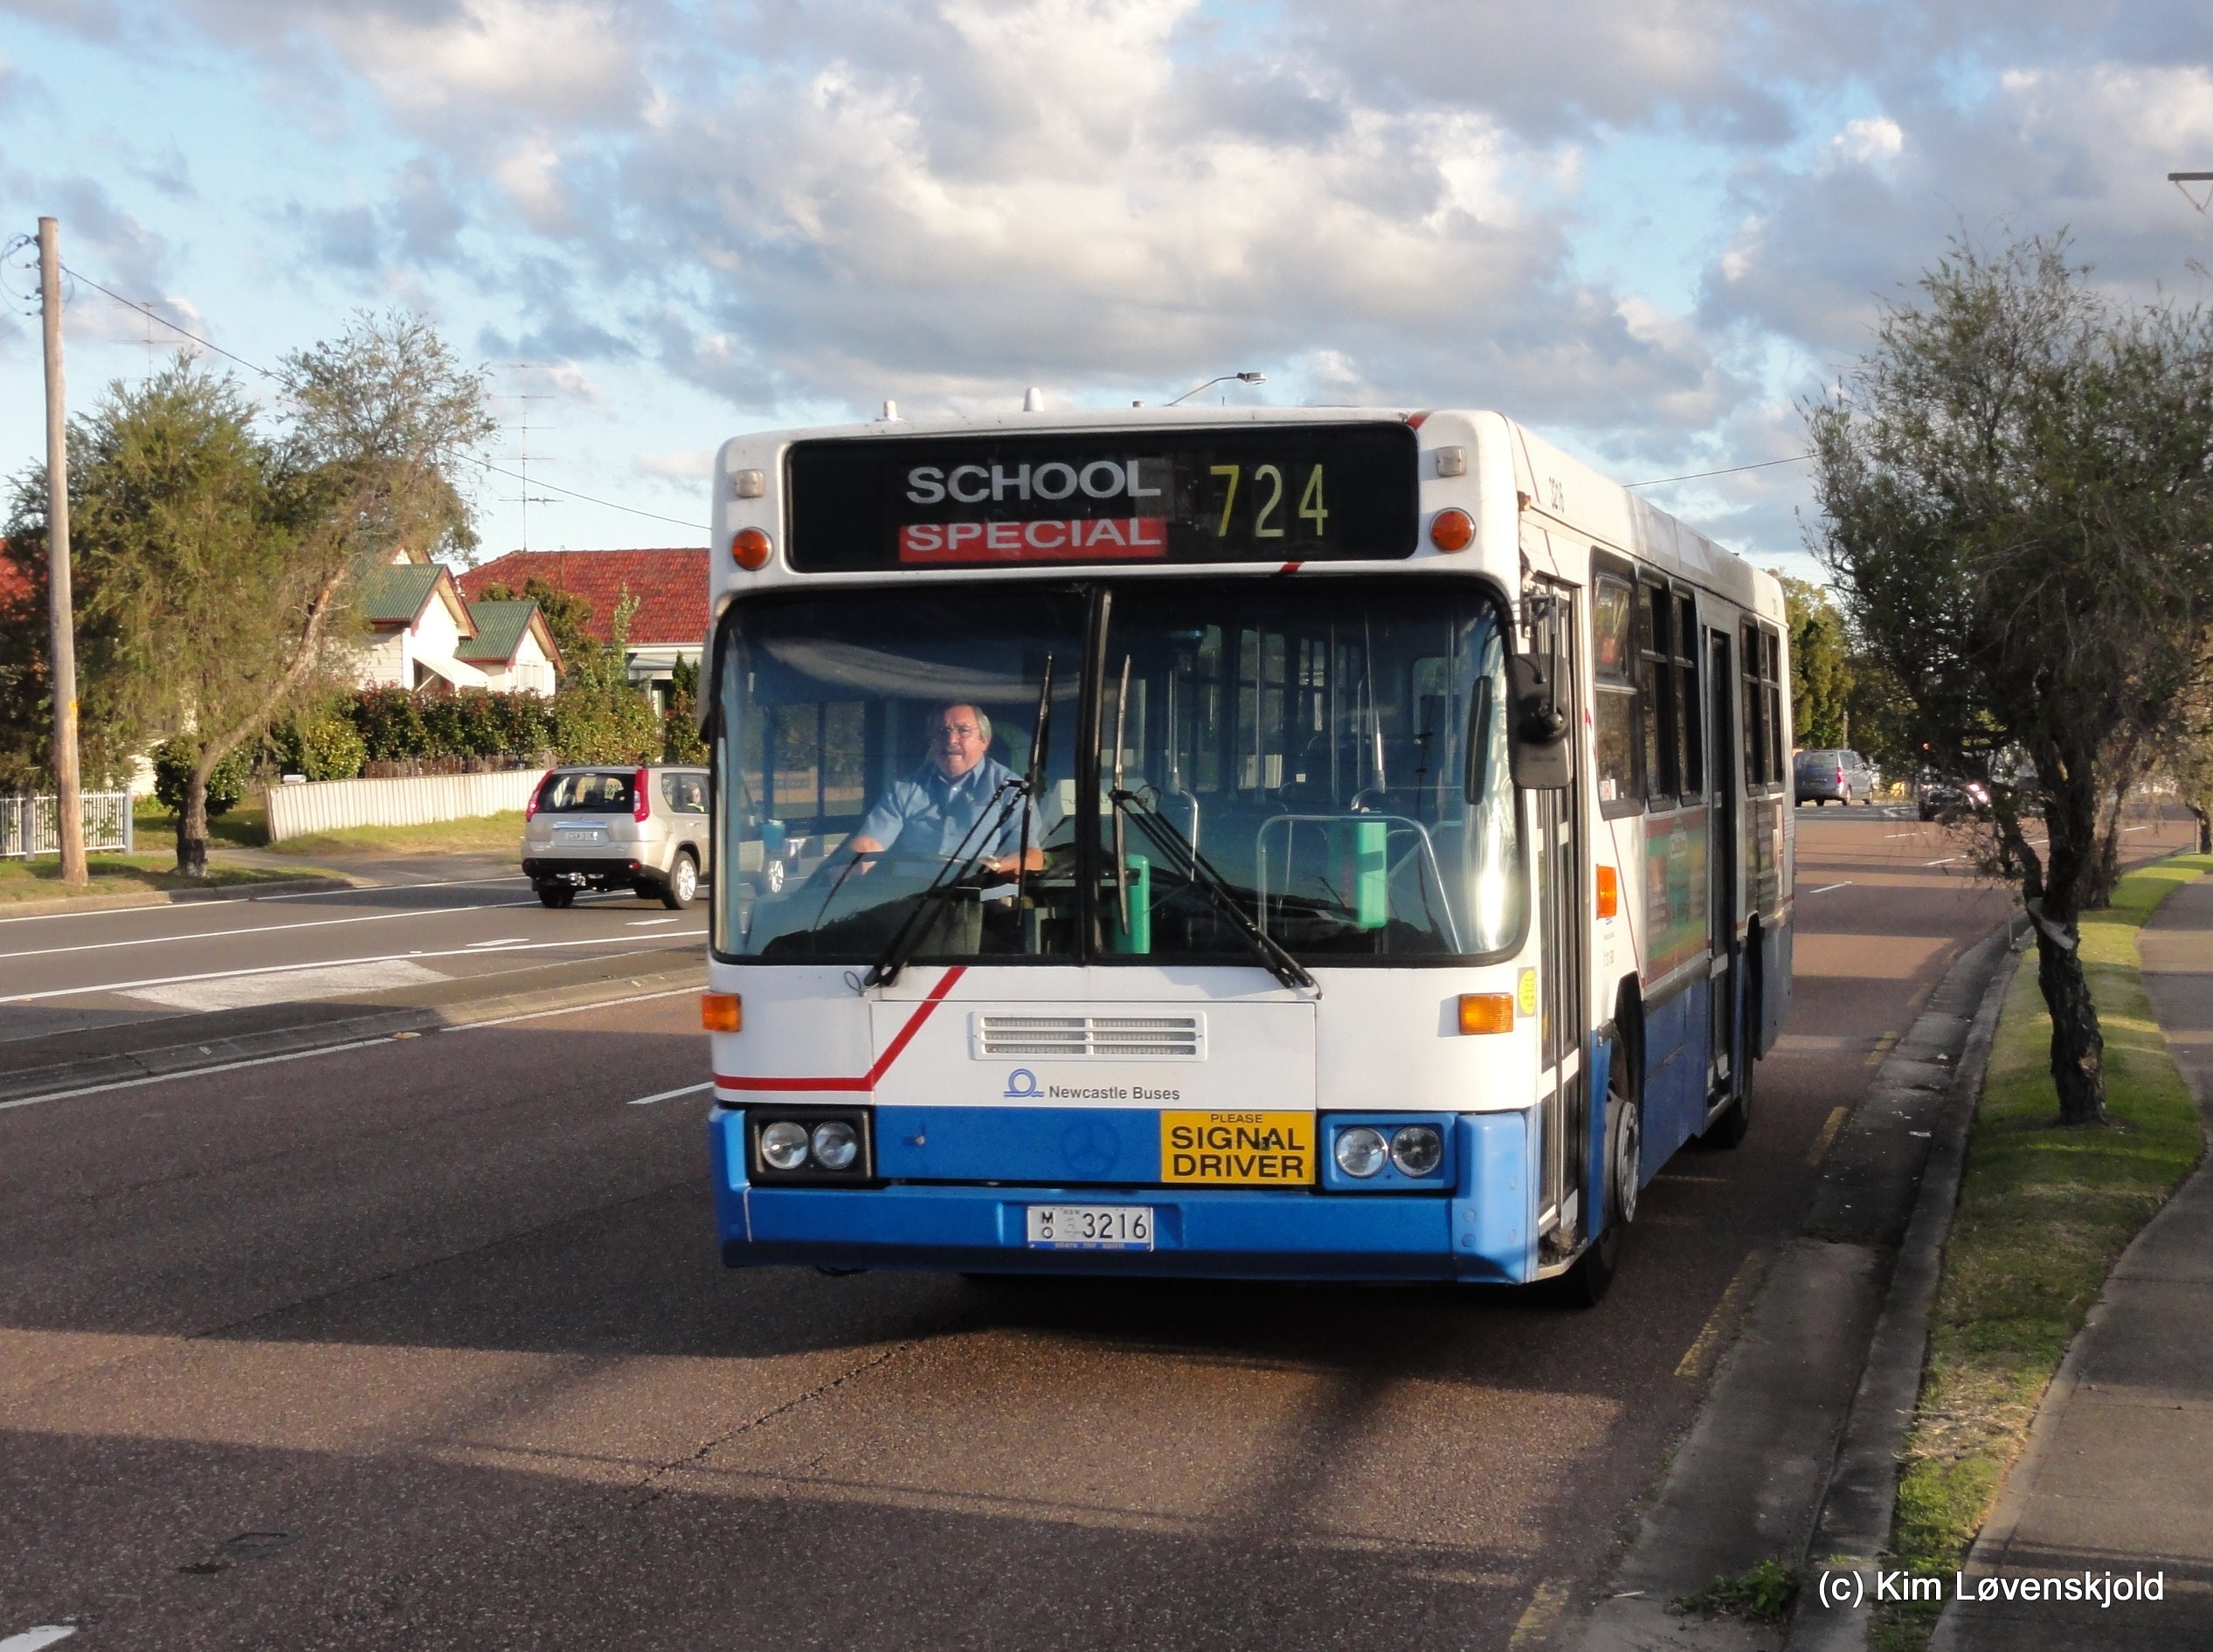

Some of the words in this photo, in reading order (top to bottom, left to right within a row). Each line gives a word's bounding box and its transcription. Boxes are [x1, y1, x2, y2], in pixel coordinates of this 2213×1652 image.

[906, 460, 1161, 504] SCHOOL
[1209, 464, 1328, 537] 724
[906, 518, 1161, 551] SPECIAL
[1048, 1085, 1127, 1099] Newcastle
[1132, 1087, 1179, 1100] Buses
[1210, 1113, 1263, 1123] PLEASE
[1171, 1126, 1304, 1151] SIGNAL
[1173, 1154, 1304, 1179] DRIVER
[1082, 1213, 1146, 1239] 3216
